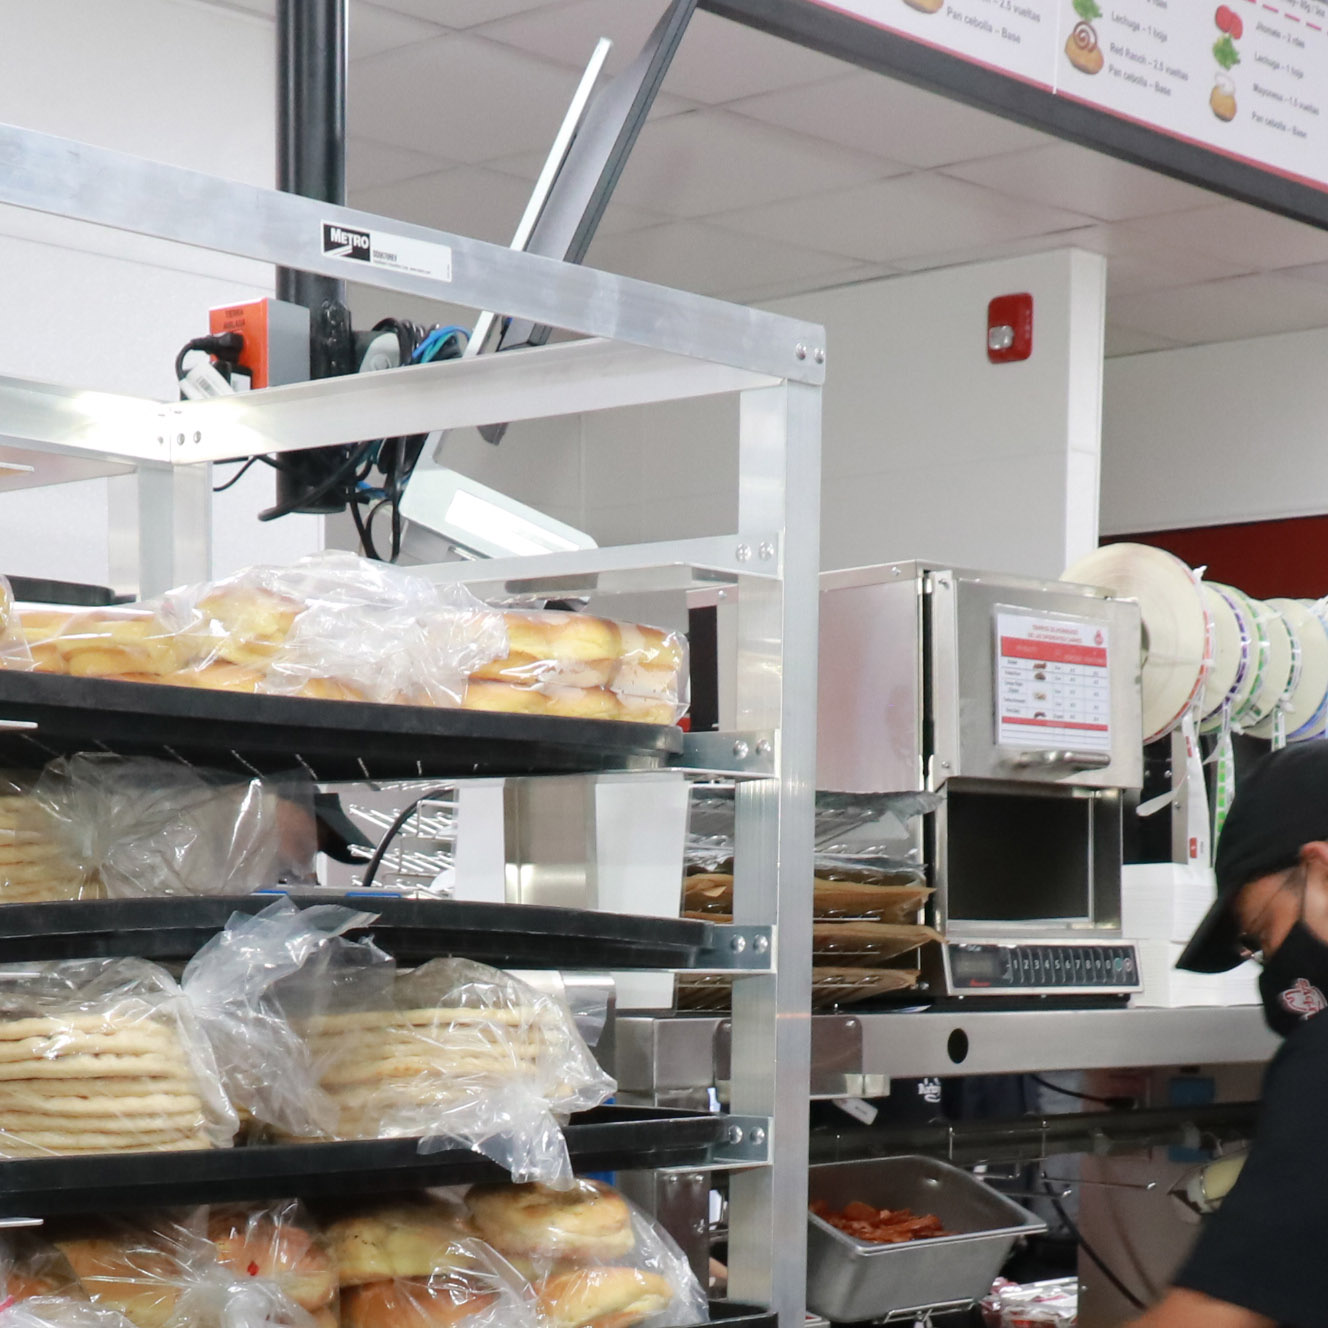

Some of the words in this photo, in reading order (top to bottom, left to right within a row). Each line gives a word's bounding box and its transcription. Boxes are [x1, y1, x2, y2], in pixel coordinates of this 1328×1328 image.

[945, 6, 963, 24] Pan
[964, 15, 993, 33] cebolla
[1001, 27, 1021, 44] Base
[330, 228, 370, 250] METRO
